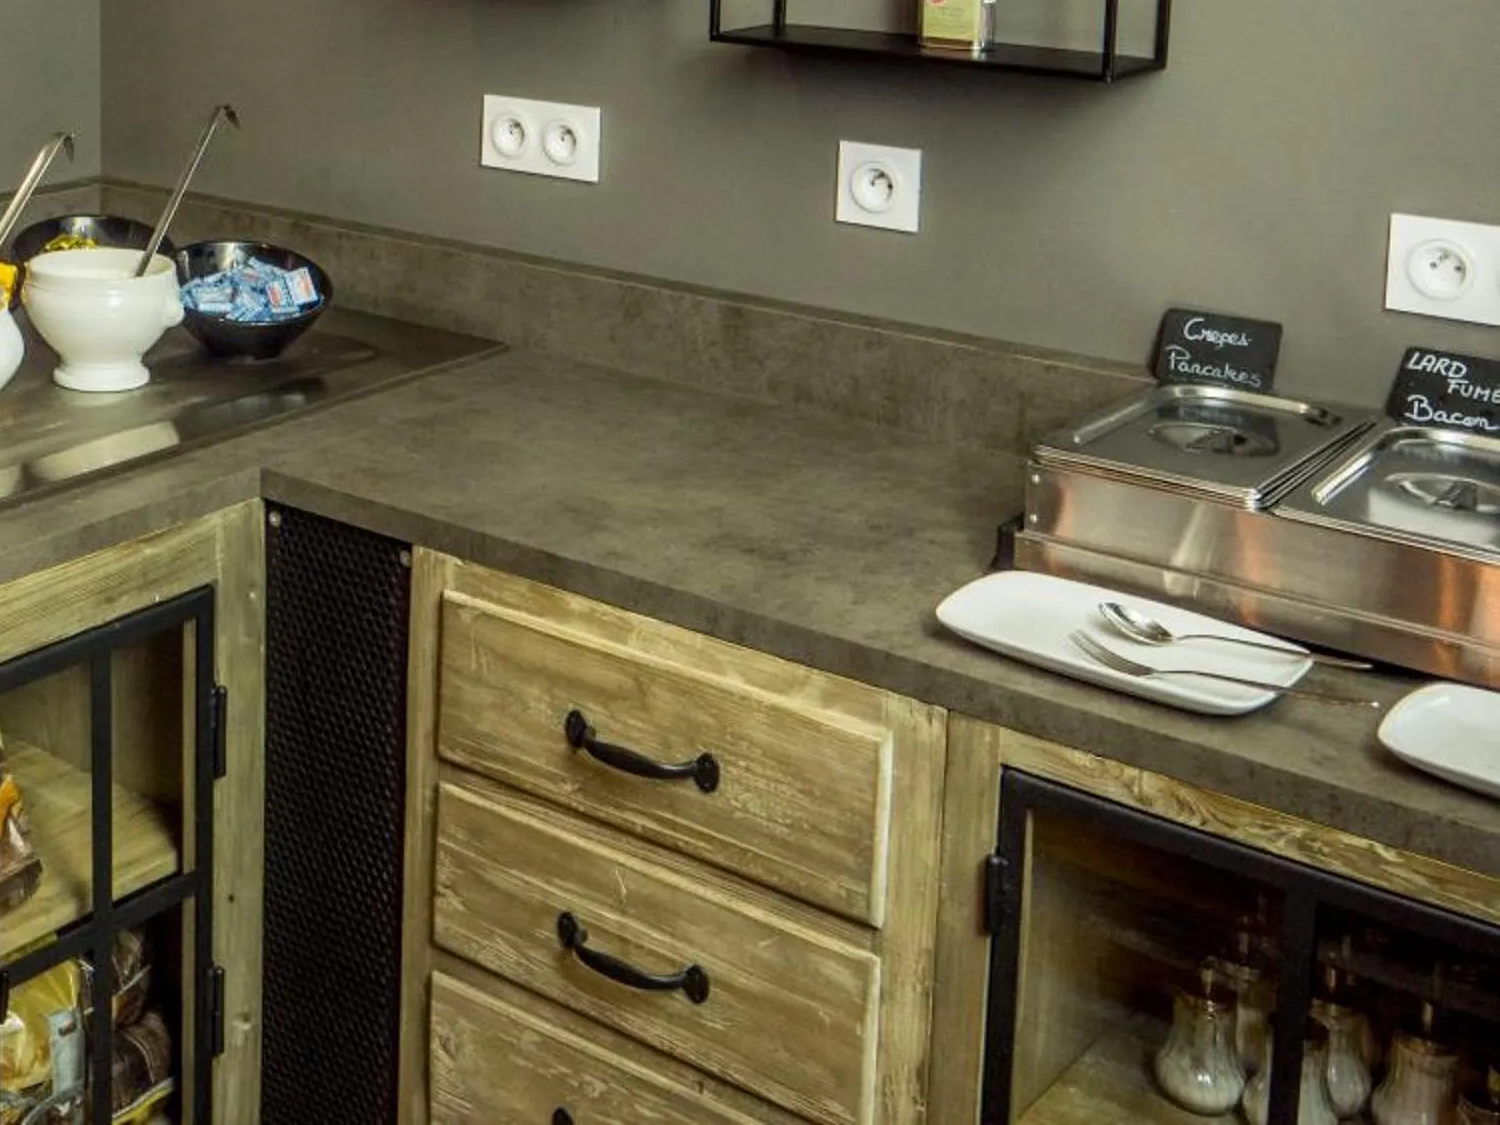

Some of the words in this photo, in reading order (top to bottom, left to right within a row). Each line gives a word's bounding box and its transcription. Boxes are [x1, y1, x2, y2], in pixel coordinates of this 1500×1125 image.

[1165, 344, 1262, 388] Pancakes
[1407, 352, 1467, 378] LARD
[1404, 394, 1500, 430] Bacon
